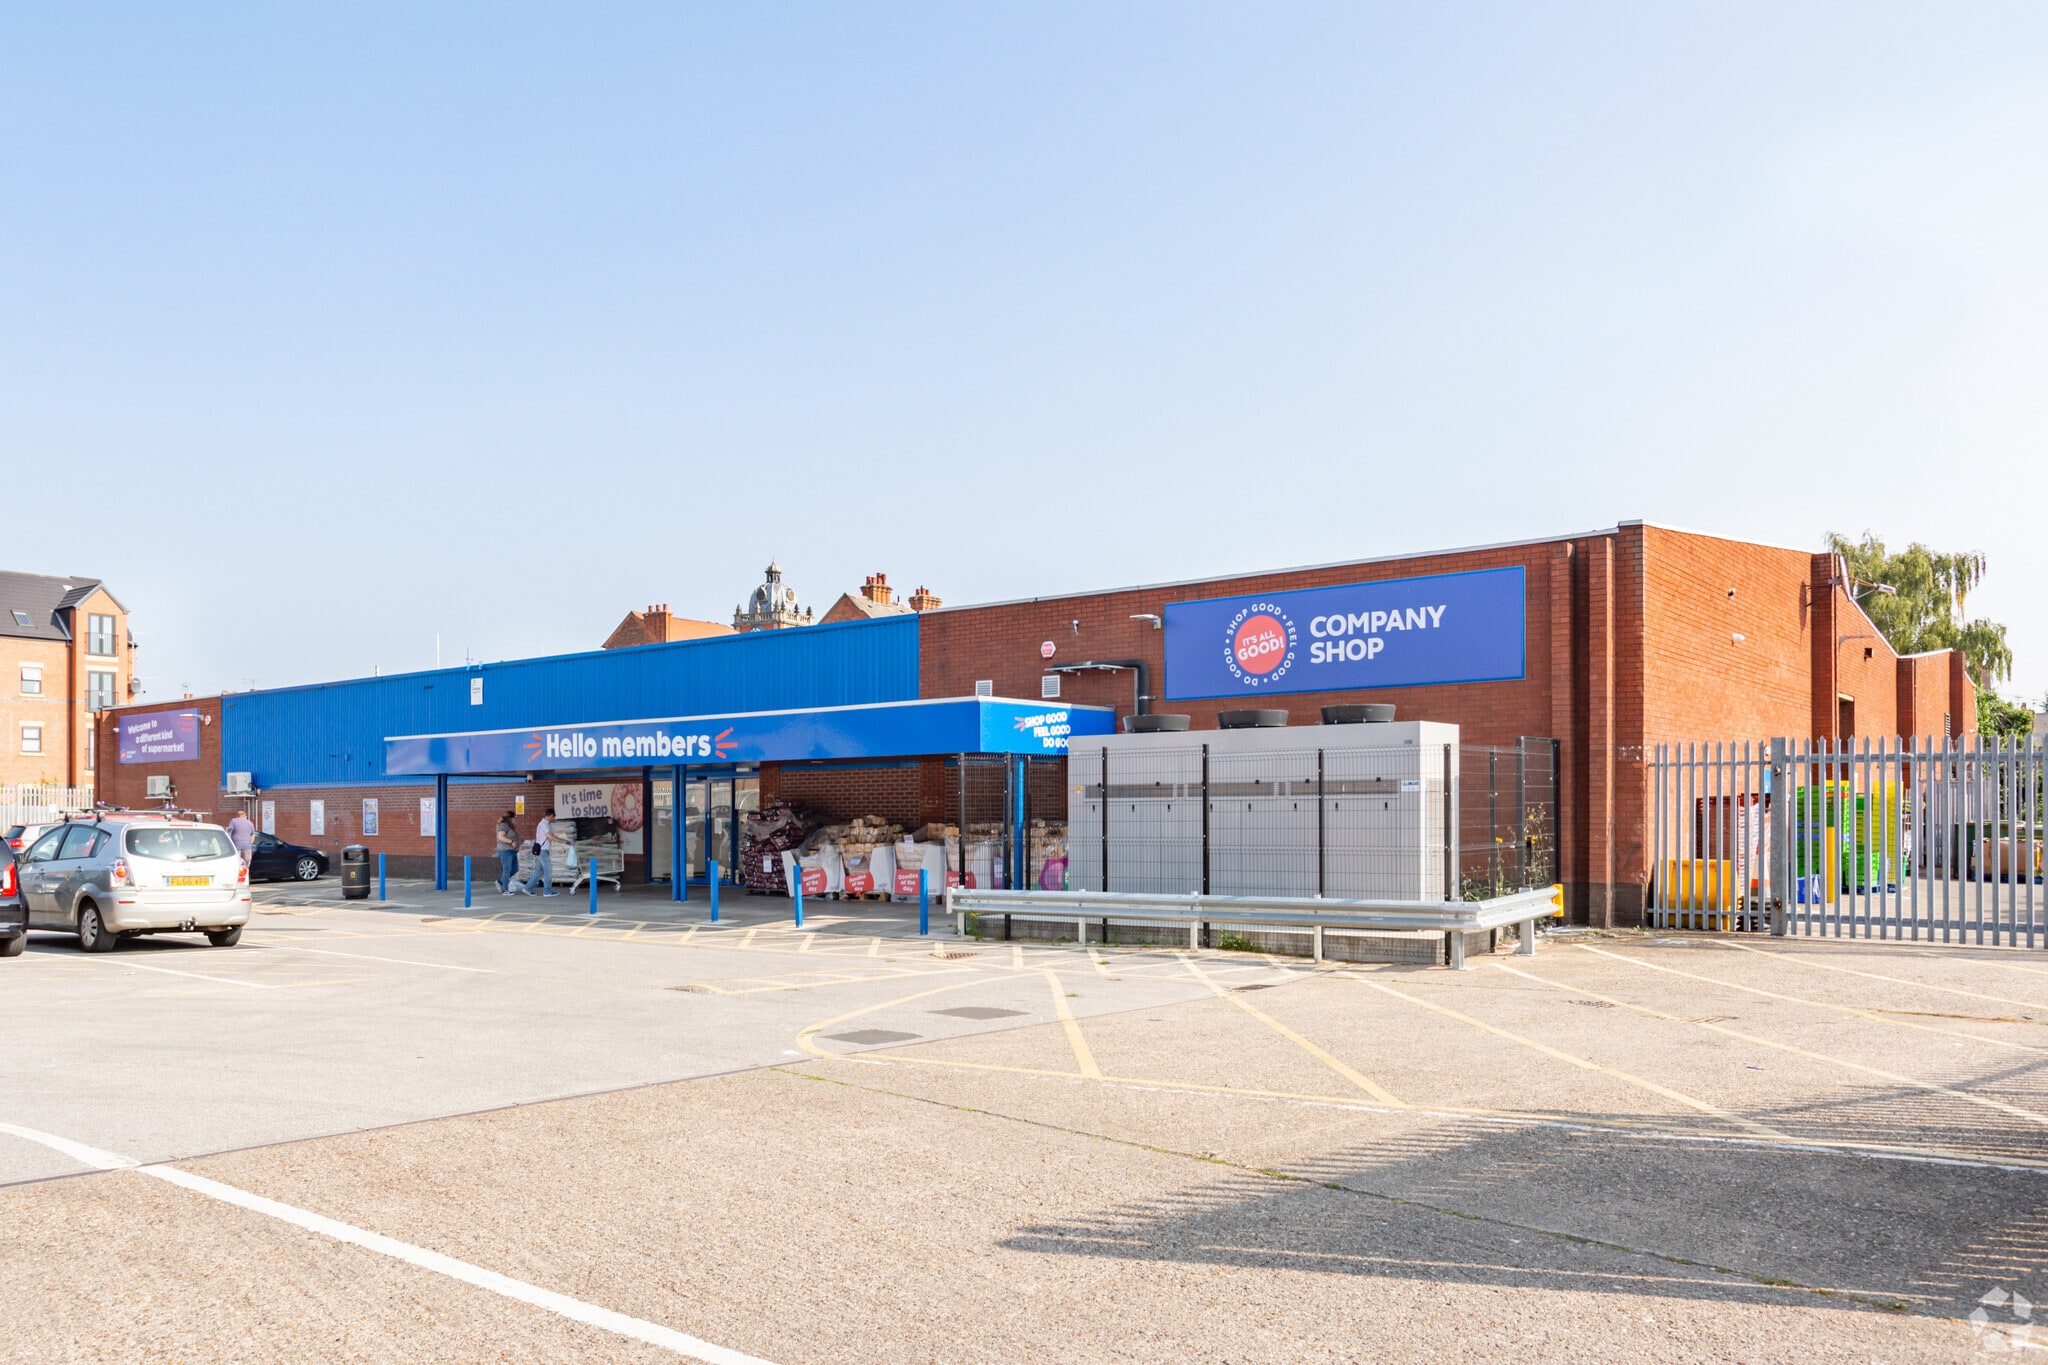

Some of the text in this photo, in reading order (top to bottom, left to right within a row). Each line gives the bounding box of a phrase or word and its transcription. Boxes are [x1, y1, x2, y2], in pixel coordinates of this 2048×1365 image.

[1309, 604, 1447, 638] COMPANY
[1223, 602, 1298, 687] SHOP GOOD FEEL GOOD DO GOOD
[1242, 630, 1276, 647] IT'S ALL
[1237, 635, 1285, 661] GOOD!
[1309, 637, 1385, 664] SHOP
[128, 720, 157, 735] Welcome to
[1024, 711, 1067, 728] SHOP GOOD
[140, 732, 161, 742] different
[162, 730, 173, 739] kind
[1033, 725, 1071, 738] FEEL GOOD
[142, 743, 184, 754] of supermarket!
[546, 730, 712, 758] Hello members
[1043, 738, 1068, 747] DO GO
[561, 788, 603, 806] It's time
[571, 803, 609, 817] to shop
[803, 872, 821, 882] Goodies
[902, 886, 914, 894] day
